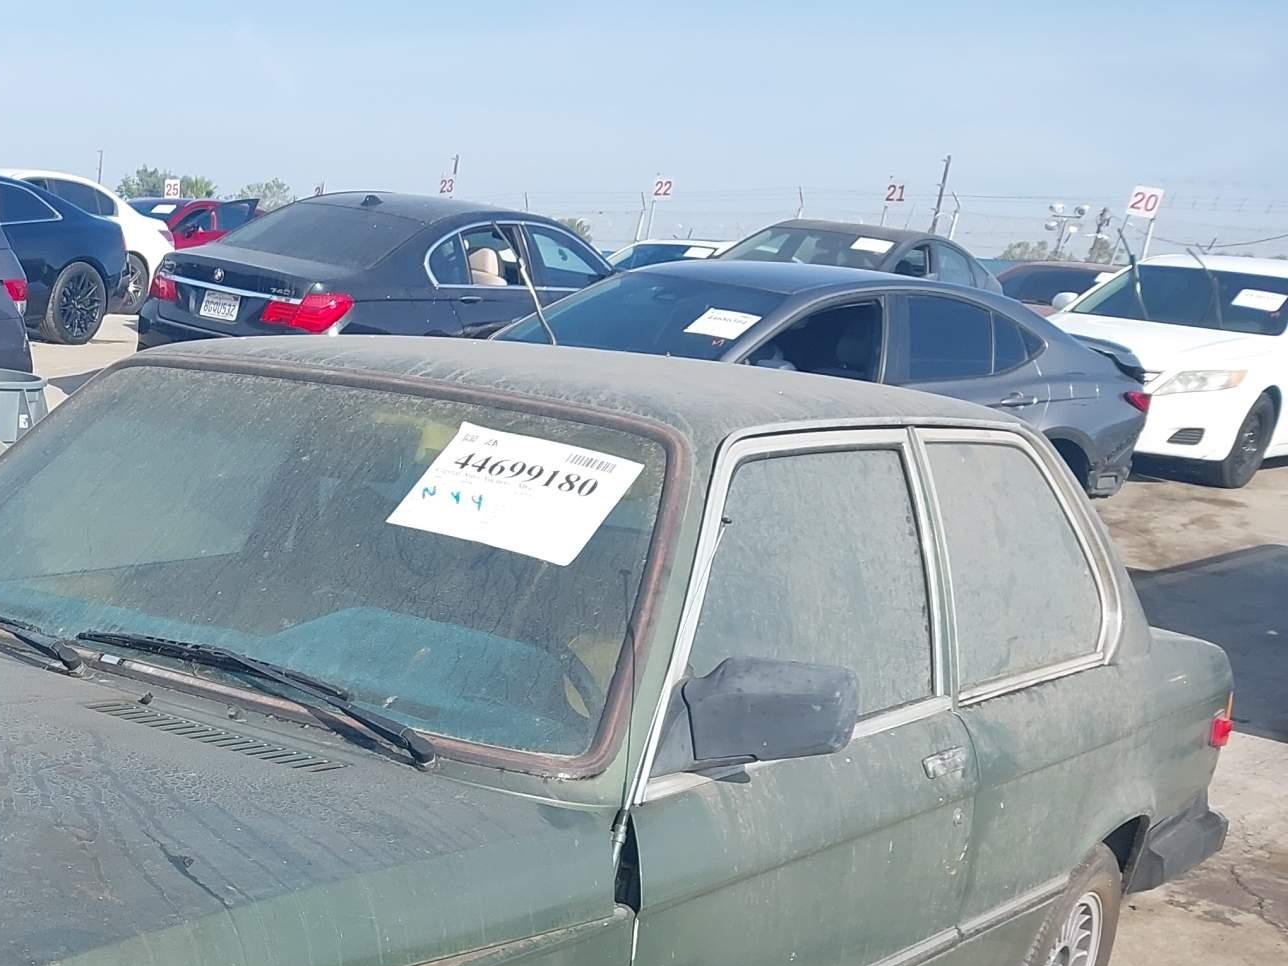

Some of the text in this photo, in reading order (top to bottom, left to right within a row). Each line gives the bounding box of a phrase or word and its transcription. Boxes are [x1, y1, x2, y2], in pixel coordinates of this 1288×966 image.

[165, 183, 179, 197] 25
[439, 178, 454, 194] 23
[653, 180, 673, 196] 22
[885, 184, 906, 203] 21
[1129, 191, 1160, 213] 20
[454, 452, 599, 497] 44699180
